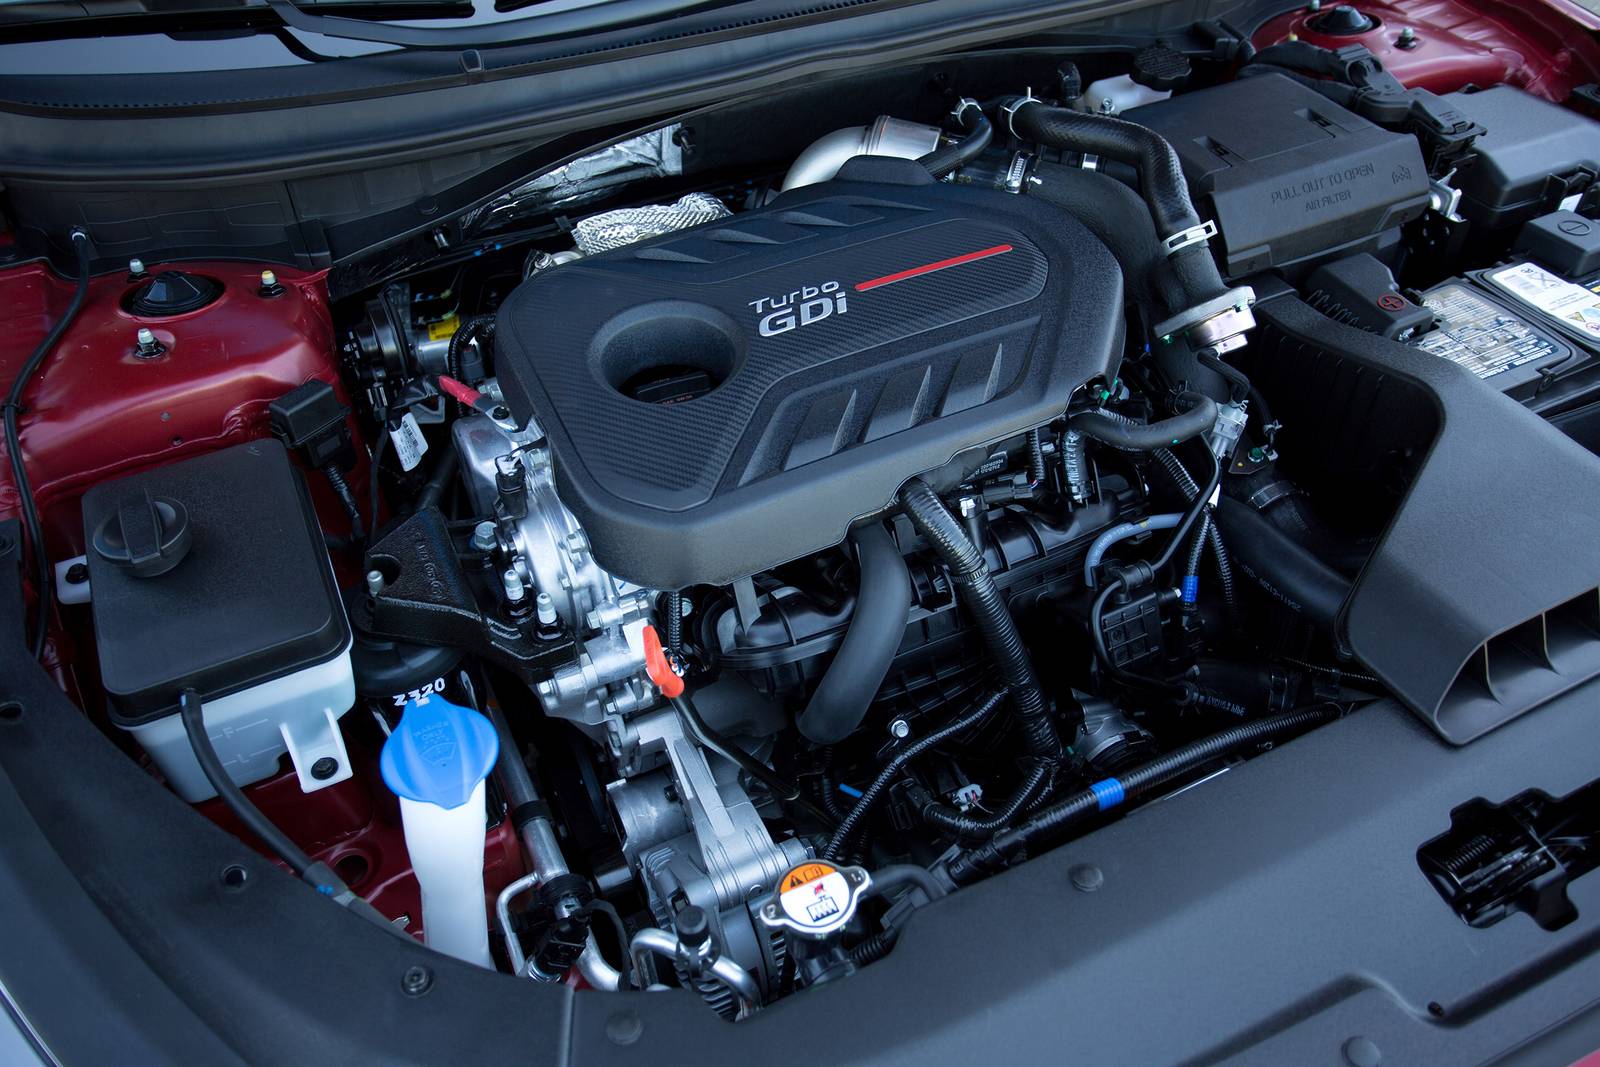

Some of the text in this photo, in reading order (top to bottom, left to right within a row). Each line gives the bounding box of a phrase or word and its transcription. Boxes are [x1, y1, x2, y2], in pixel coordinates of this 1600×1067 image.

[1271, 163, 1375, 204] PULL OUT TO OPEN
[1305, 189, 1352, 212] AIR FILTER
[748, 281, 840, 314] Turbo
[759, 291, 848, 337] GDi
